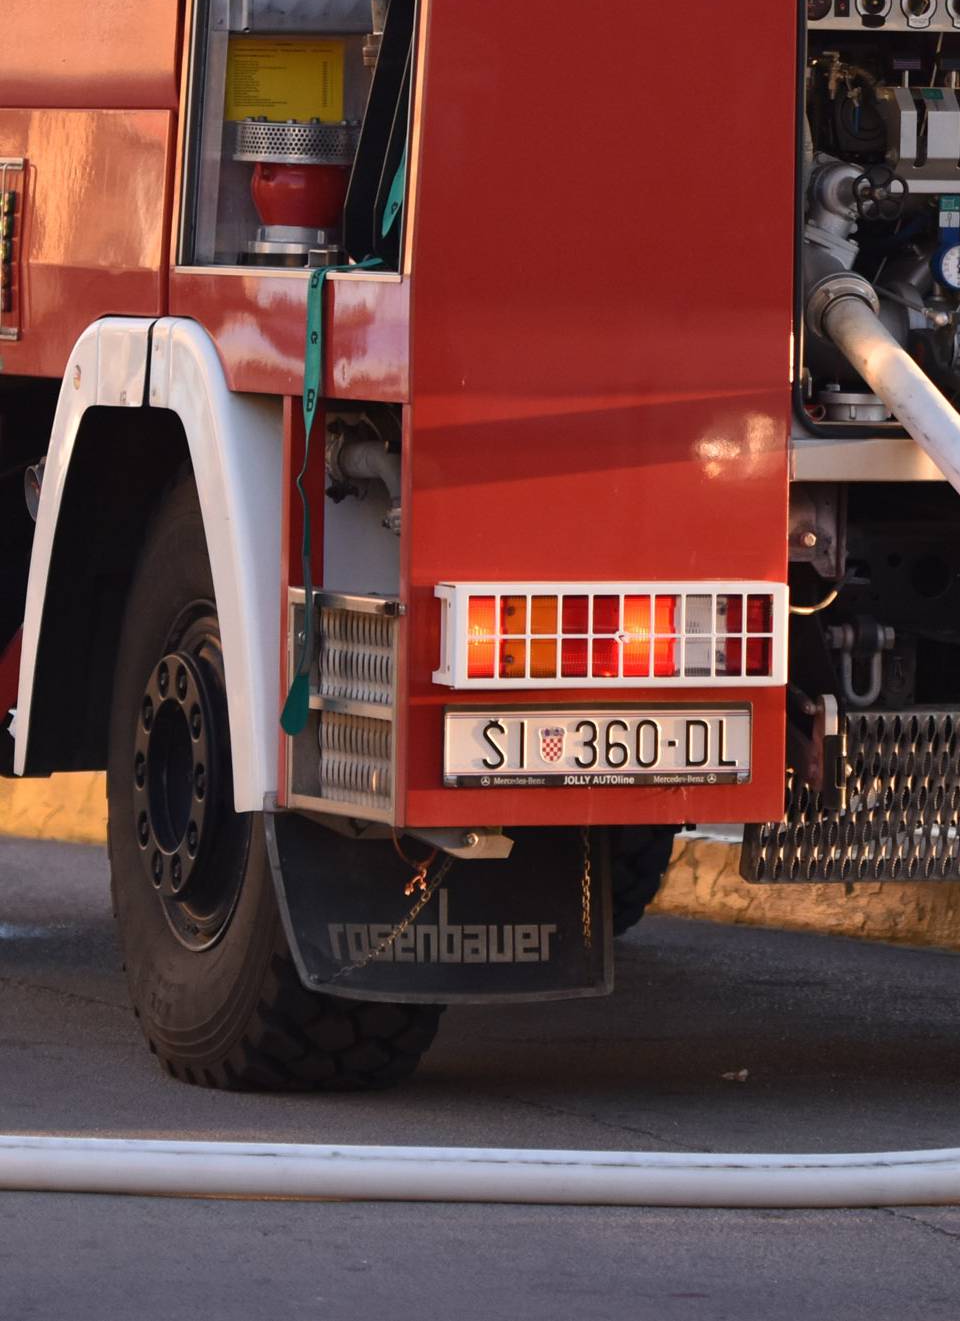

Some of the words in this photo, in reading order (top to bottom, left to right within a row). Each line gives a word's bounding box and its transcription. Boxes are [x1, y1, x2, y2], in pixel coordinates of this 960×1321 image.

[481, 718, 527, 770] ŠI
[574, 719, 738, 769] 360-DL
[563, 775, 590, 785] JOLLY
[592, 775, 635, 785] AUTOline
[653, 774, 704, 784] Mercedes-Benz
[328, 888, 557, 964] rosenbauer
